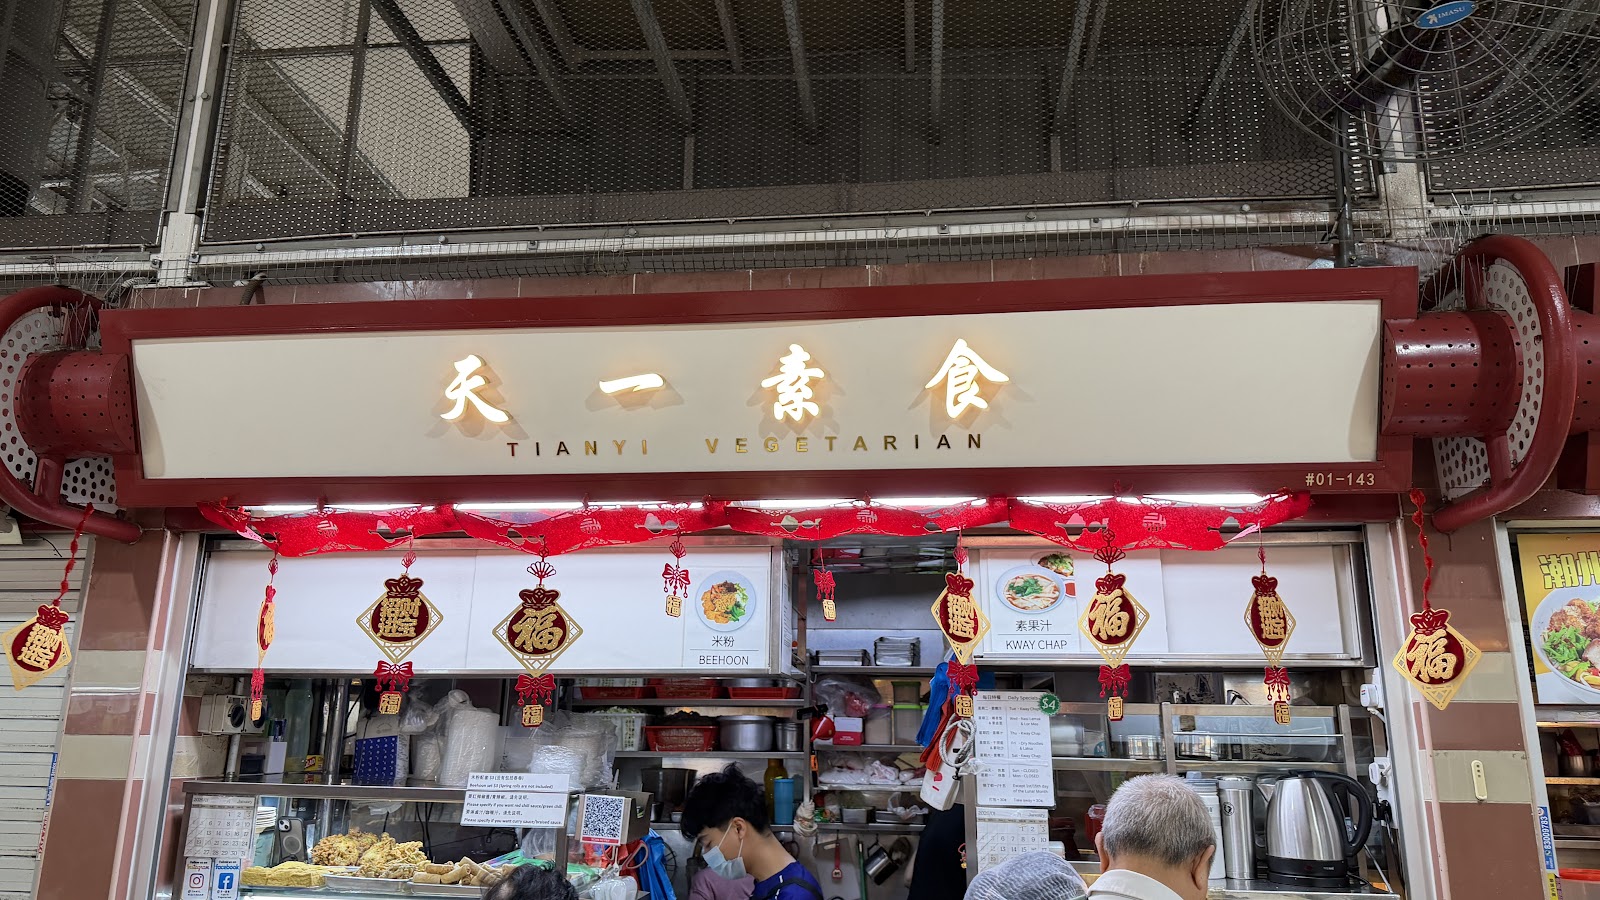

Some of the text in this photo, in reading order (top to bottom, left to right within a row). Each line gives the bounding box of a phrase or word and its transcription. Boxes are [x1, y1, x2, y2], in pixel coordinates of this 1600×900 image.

[1438, 6, 1466, 19] IMASU
[440, 338, 1010, 423] 天一素食
[506, 434, 984, 458] TIANYI VEGETARIAN
[1305, 472, 1375, 486] #01-143
[1088, 589, 1130, 640] 福
[512, 606, 563, 652] 福
[712, 636, 735, 648] 米粉
[1006, 640, 1068, 650] KWAY CHAP
[699, 655, 749, 666] BEEHOON
[1408, 629, 1457, 682] 福
[380, 694, 401, 714] 福
[956, 697, 973, 716] 福
[1042, 697, 1056, 710] $4
[1108, 698, 1122, 718] 福
[522, 705, 543, 726] 福
[1276, 704, 1290, 724] 福
[1540, 816, 1552, 850] 83009783
